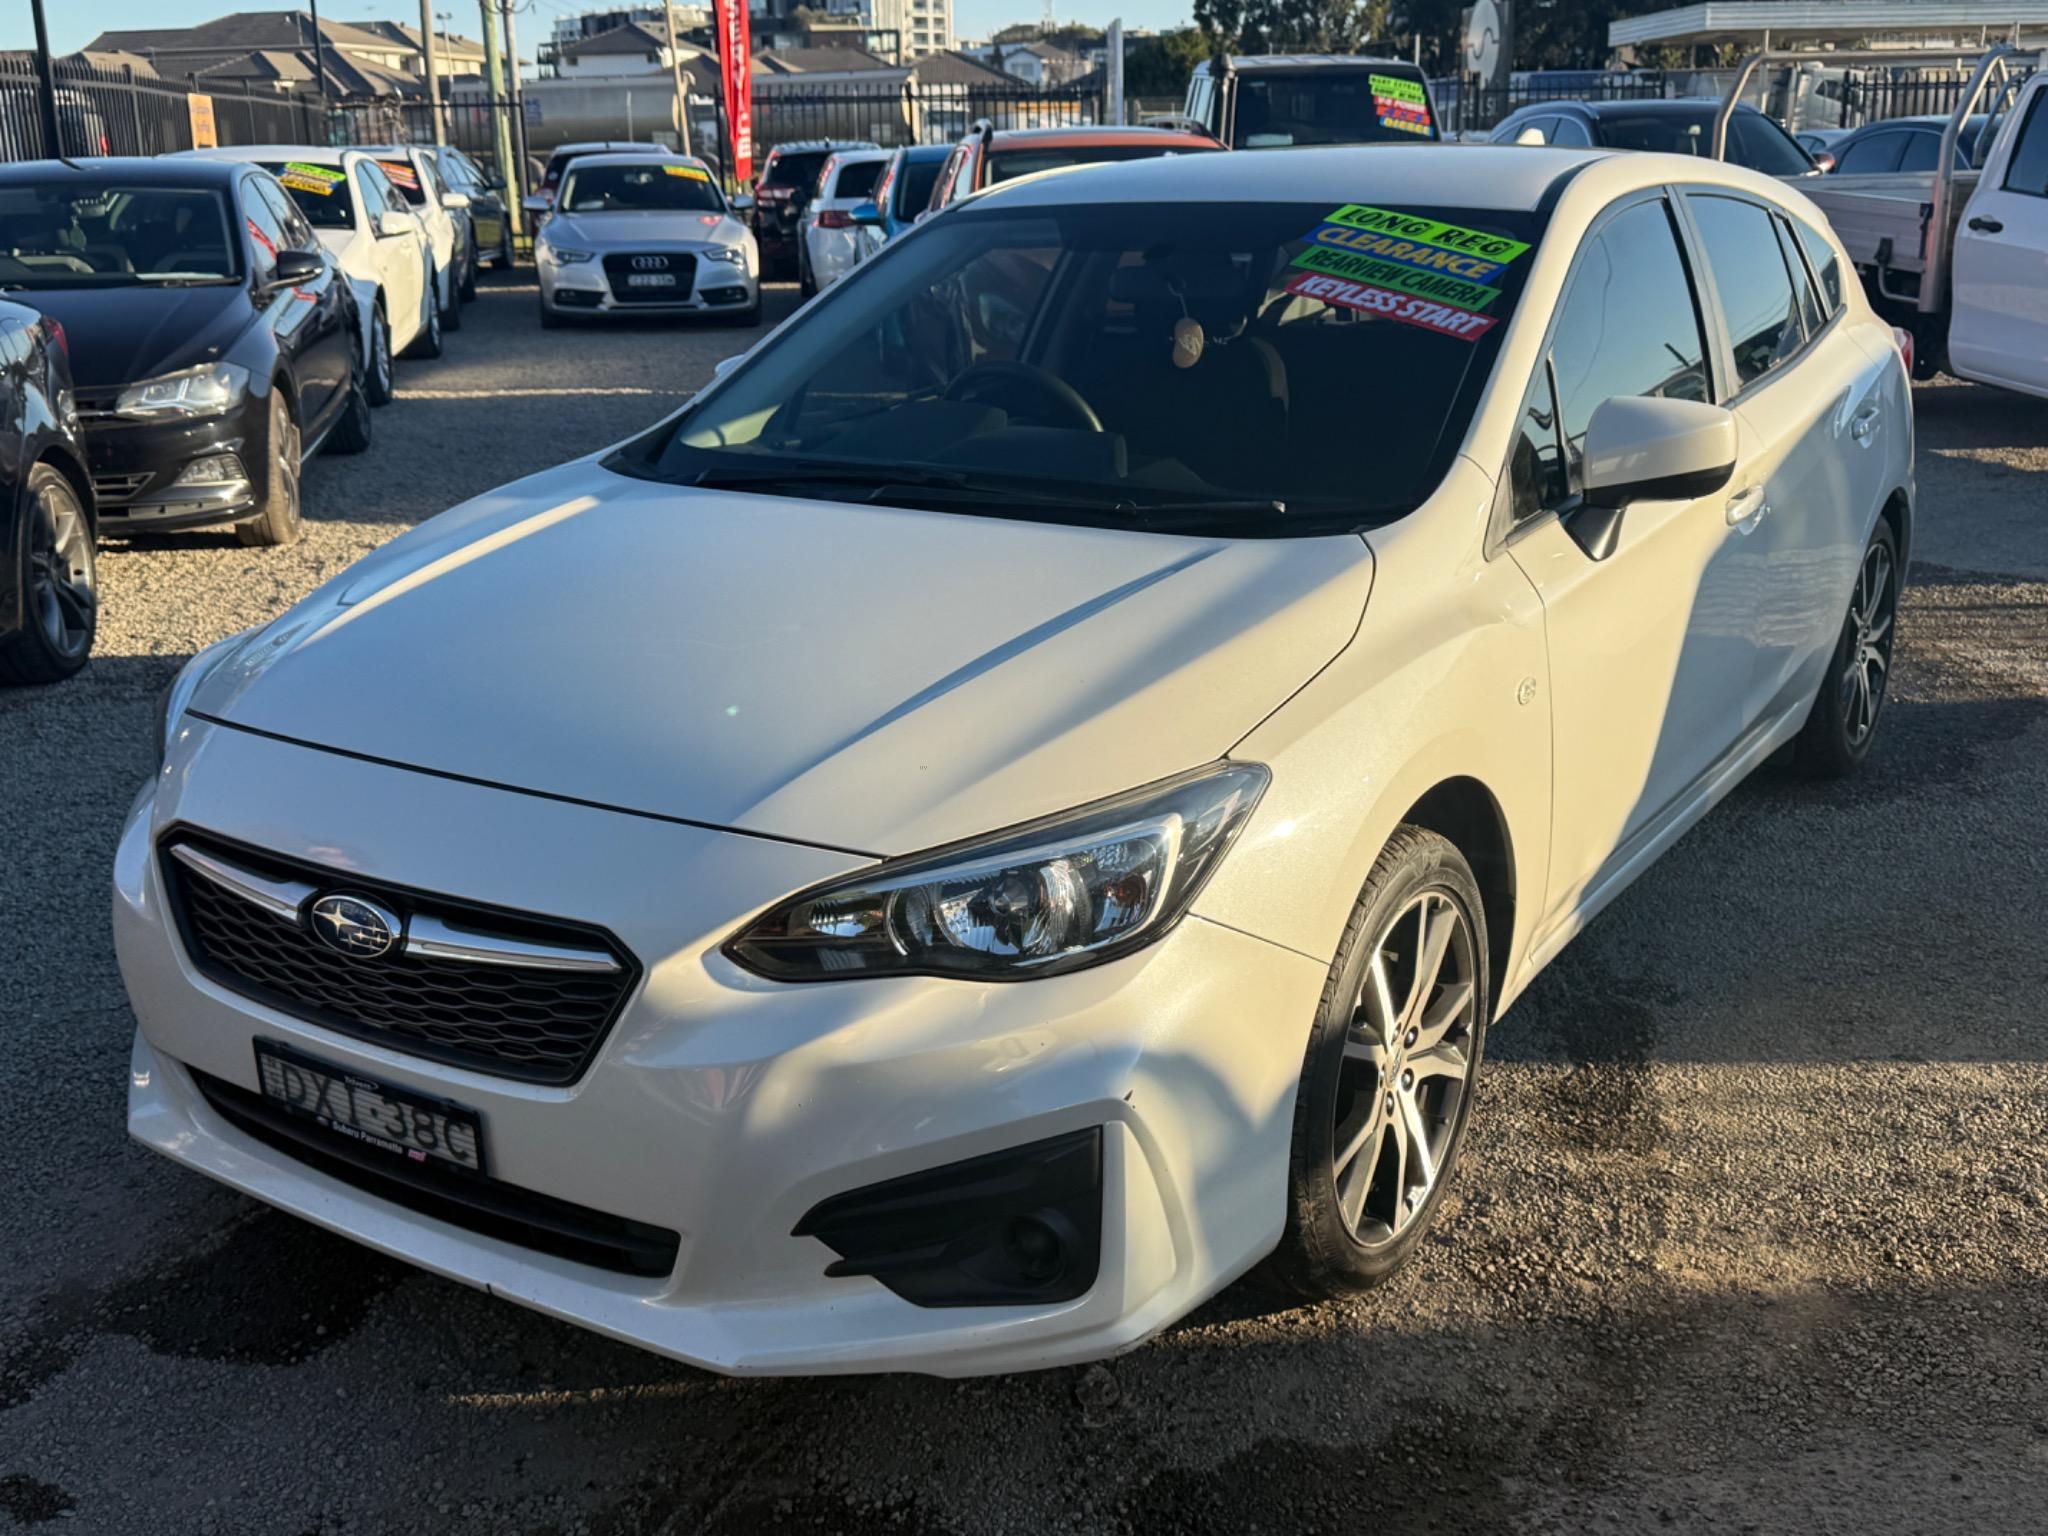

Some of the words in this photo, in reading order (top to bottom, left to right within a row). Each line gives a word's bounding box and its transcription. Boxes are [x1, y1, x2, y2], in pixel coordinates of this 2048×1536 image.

[1384, 117, 1430, 136] DIESEL
[1317, 226, 1498, 279] CLEARANCE
[1340, 208, 1433, 236] LONG
[1432, 228, 1515, 257] REG
[1304, 249, 1405, 283] REARVIEW
[1401, 269, 1488, 306] CAMERA
[1295, 275, 1408, 314] KEYLESS
[1396, 300, 1488, 334] START
[333, 1120, 360, 1140] Subaru
[360, 1131, 404, 1155] Parramatta
